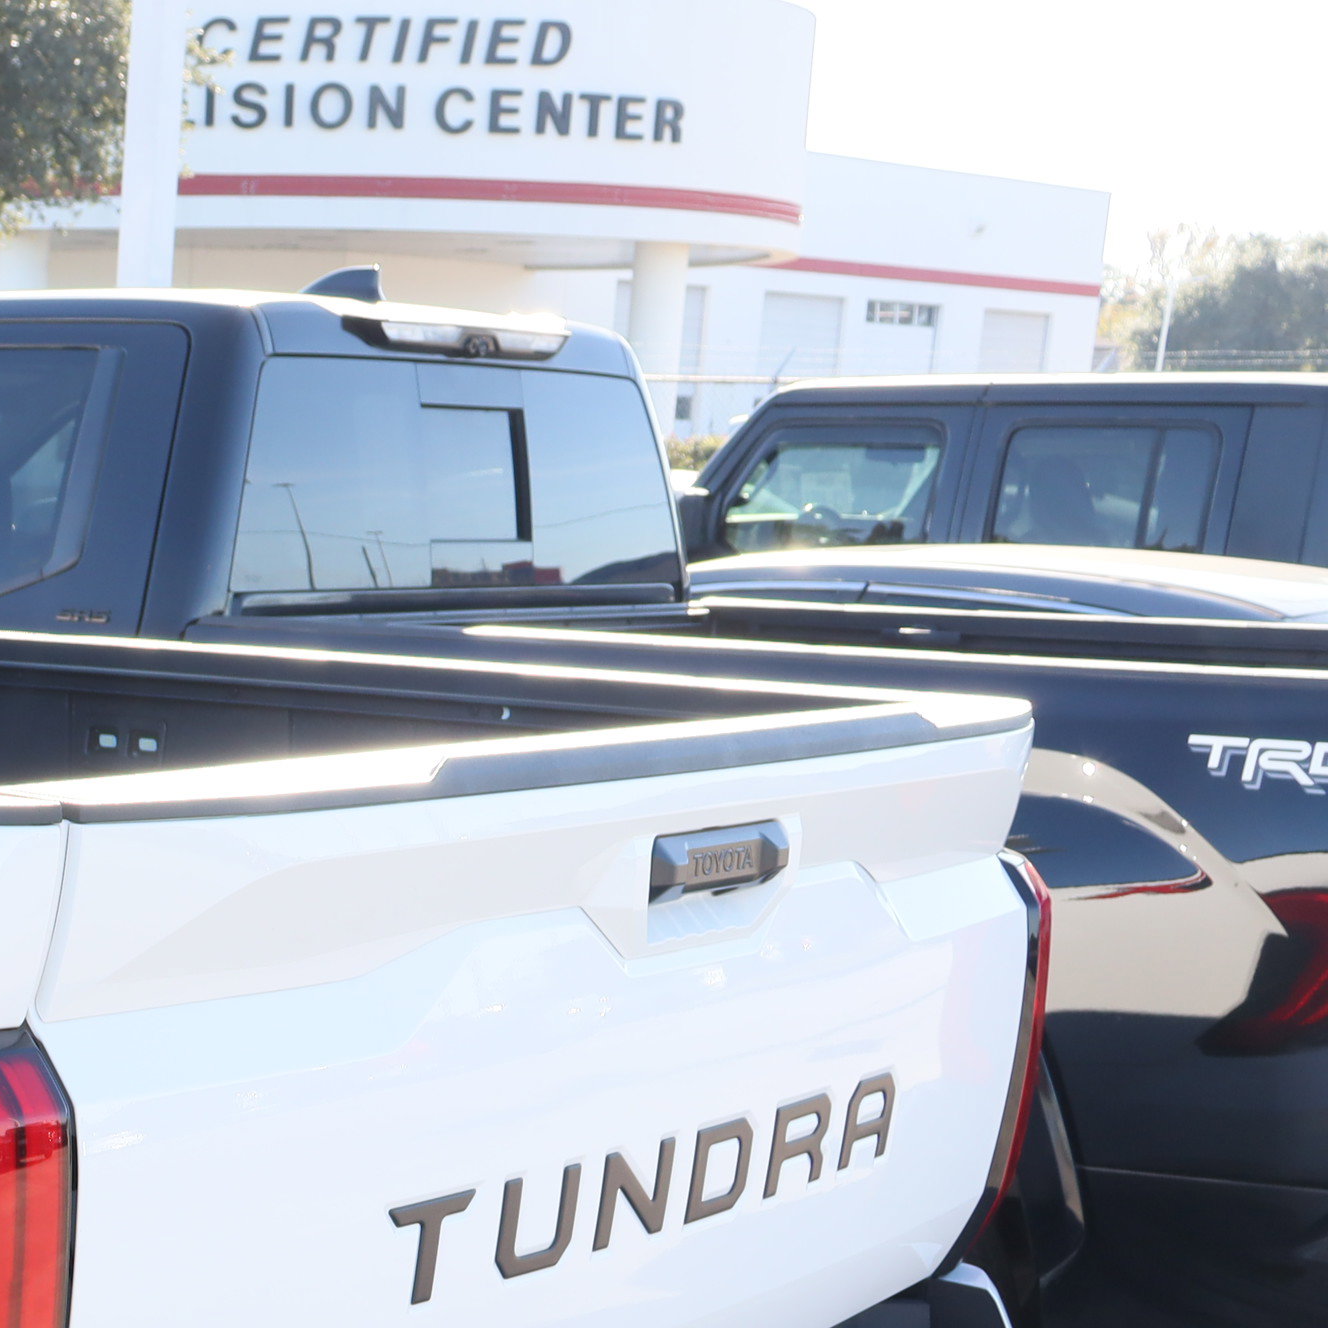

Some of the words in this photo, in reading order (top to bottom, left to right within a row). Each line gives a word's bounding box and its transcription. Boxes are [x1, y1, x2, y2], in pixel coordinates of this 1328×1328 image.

[196, 16, 572, 66] CERTIFIED
[186, 82, 407, 129] ISION
[434, 87, 685, 143] CENTER
[1188, 734, 1328, 788] TR
[693, 845, 754, 877] TOYOTA
[389, 1072, 896, 1306] TUNDRA
